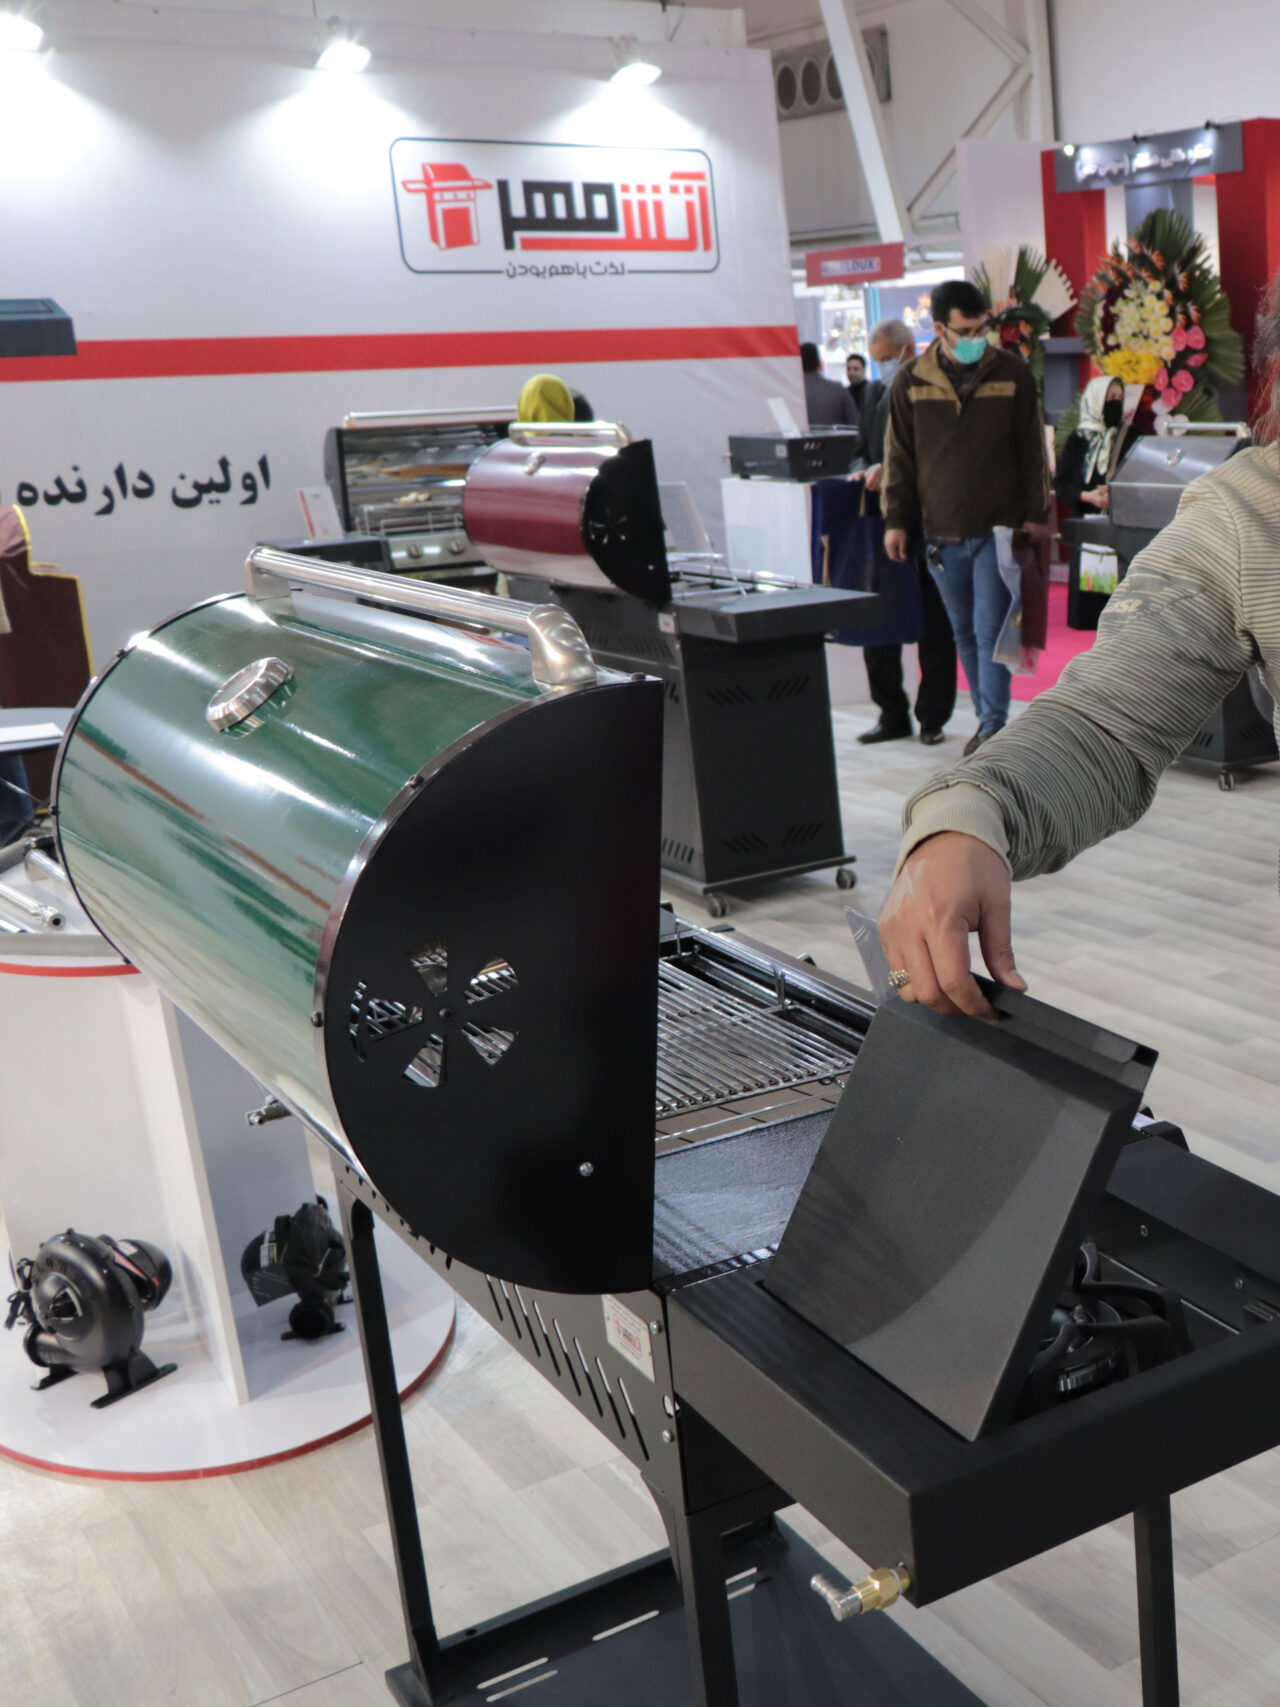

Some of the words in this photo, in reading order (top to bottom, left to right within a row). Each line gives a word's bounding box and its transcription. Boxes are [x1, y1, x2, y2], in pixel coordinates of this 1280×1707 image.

[496, 178, 619, 251] مهر
[520, 171, 711, 252] آتش
[16, 461, 156, 517] دارنده
[171, 453, 271, 509] اولین
